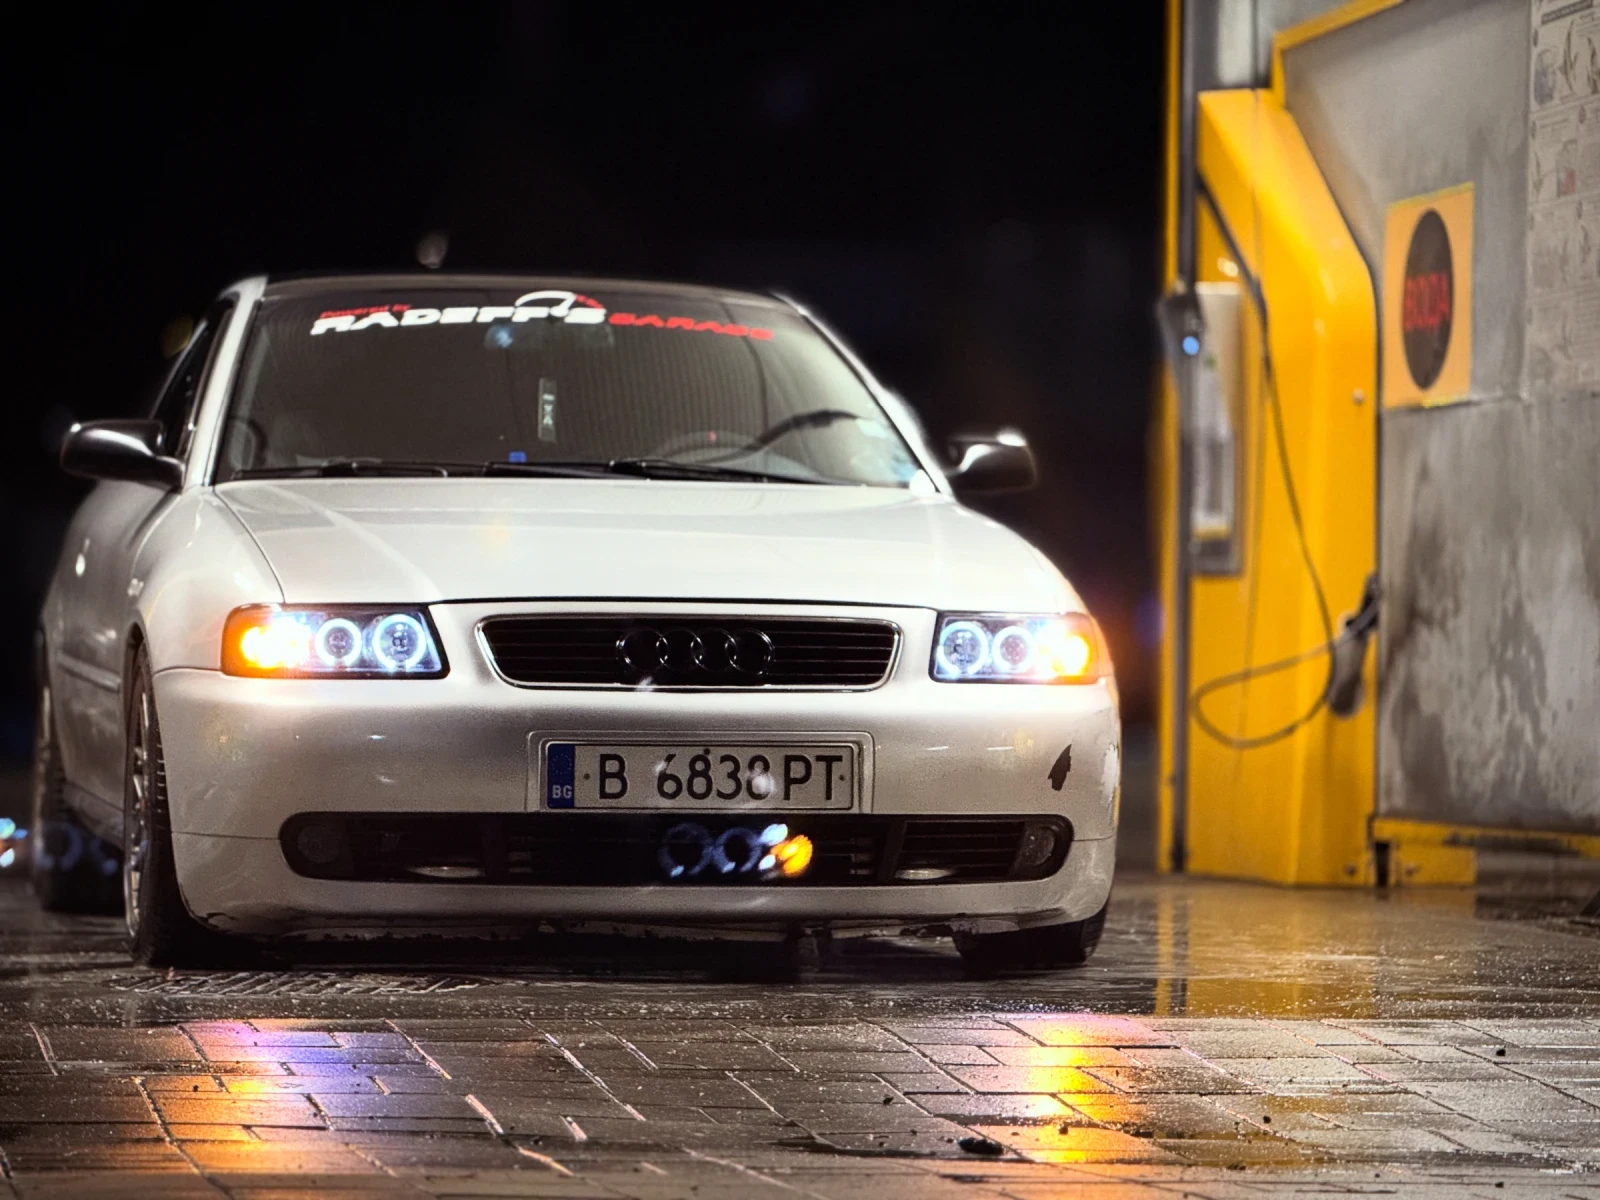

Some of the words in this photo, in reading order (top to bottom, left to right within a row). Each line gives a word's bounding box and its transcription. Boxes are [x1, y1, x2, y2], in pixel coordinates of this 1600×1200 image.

[608, 312, 774, 341] GARAGE
[599, 753, 629, 800] B
[656, 753, 772, 801] 6838
[783, 754, 843, 801] PT
[552, 785, 573, 799] BG
